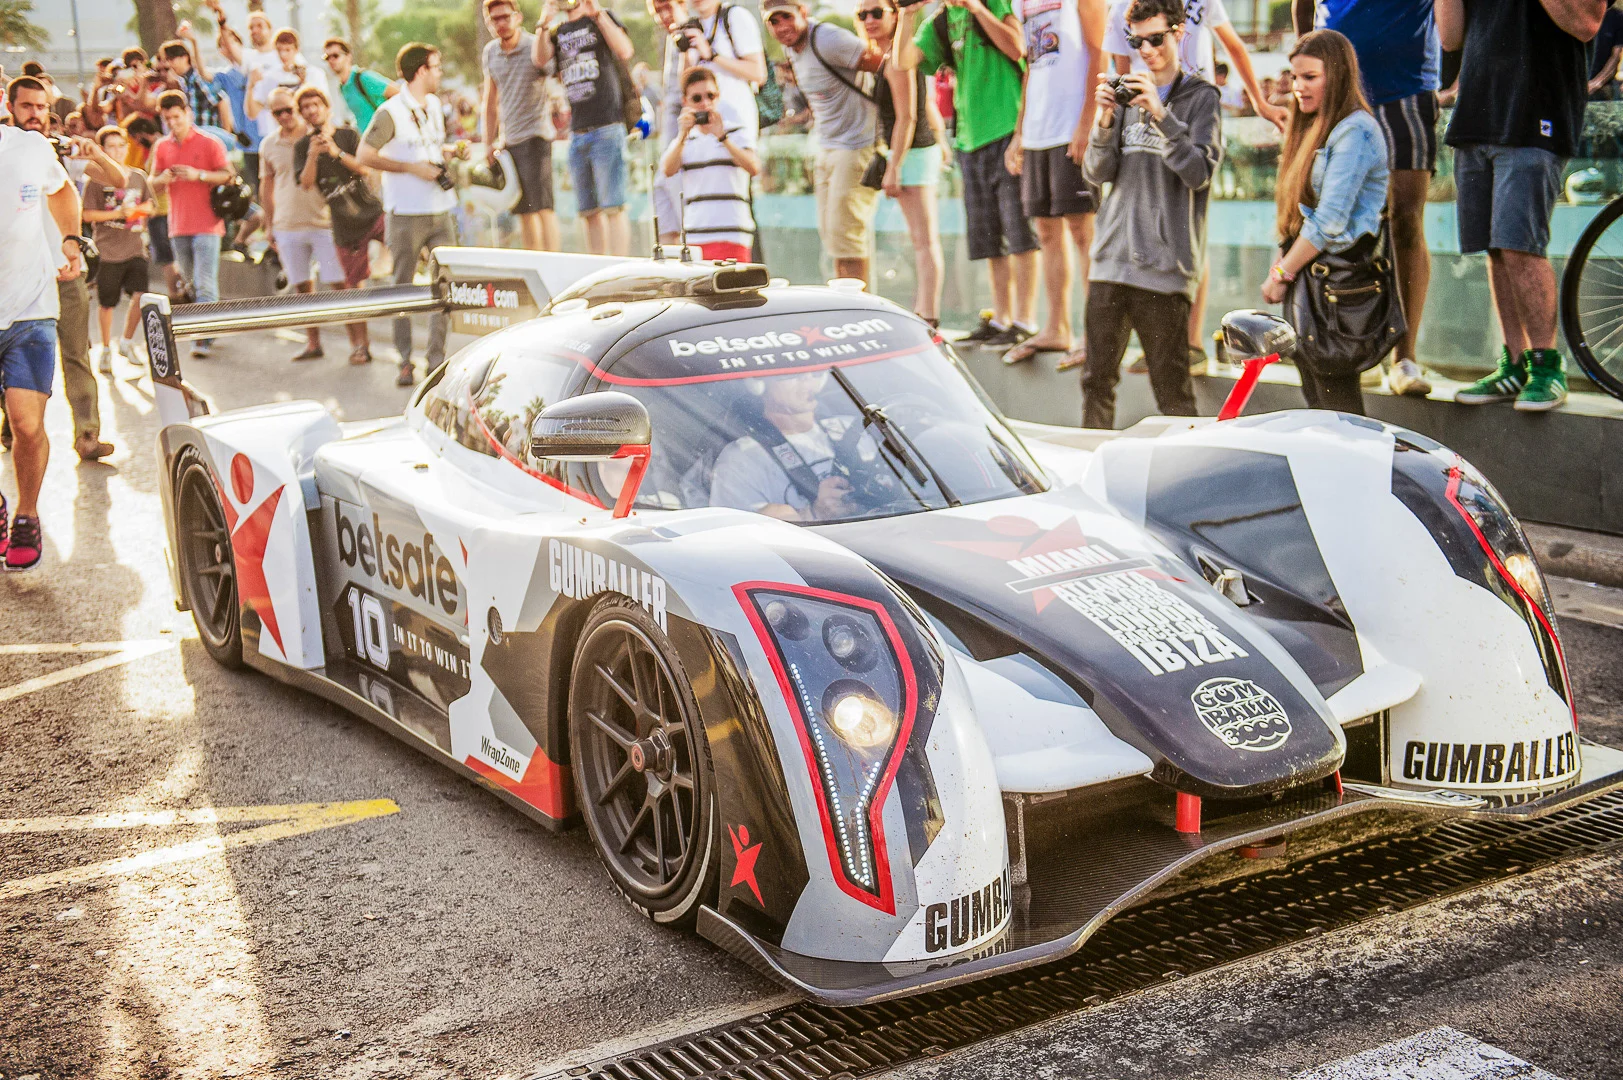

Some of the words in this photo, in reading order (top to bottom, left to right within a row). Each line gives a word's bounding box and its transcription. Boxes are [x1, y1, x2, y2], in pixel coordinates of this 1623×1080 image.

[668, 330, 802, 358] betsafe
[823, 318, 893, 339] com
[719, 358, 747, 369] IN
[752, 353, 776, 365] IT
[781, 351, 811, 361] TO
[813, 343, 857, 358] WIN
[858, 339, 888, 351] IT.
[335, 500, 458, 615] betsafe
[1006, 544, 1120, 578] MIAMI
[1049, 571, 1158, 602] ATLANTA
[1081, 591, 1188, 621] EDINBURGH
[348, 586, 390, 671] 10
[1091, 602, 1205, 632] LONDON
[1112, 616, 1220, 647] BARCELONA
[393, 623, 404, 645] IN
[407, 630, 417, 652] IT
[420, 638, 432, 661] TO
[434, 646, 457, 674] WIN
[1126, 629, 1250, 676] IBIZA
[481, 735, 520, 774] WrapZone
[1402, 731, 1576, 784] GUMBALLER
[925, 863, 1011, 953] GUMBA
